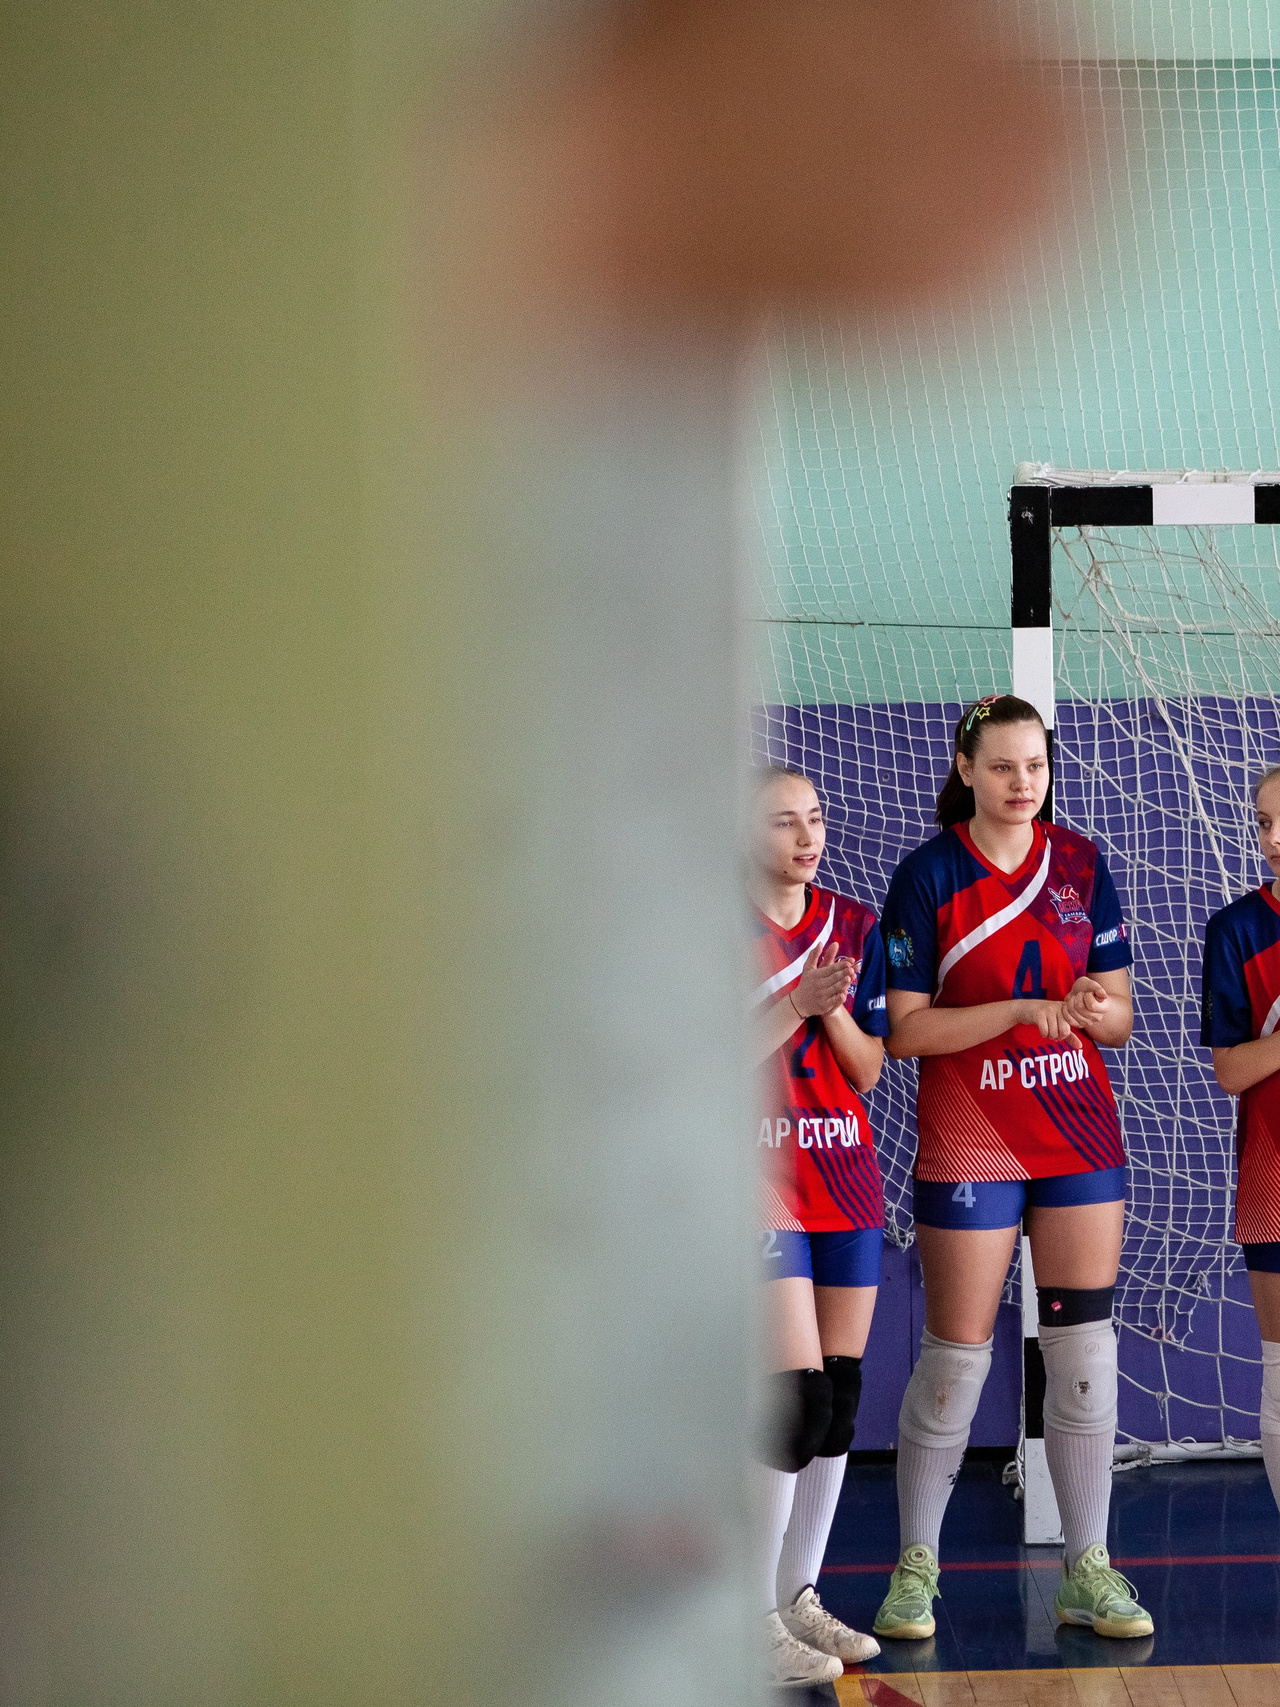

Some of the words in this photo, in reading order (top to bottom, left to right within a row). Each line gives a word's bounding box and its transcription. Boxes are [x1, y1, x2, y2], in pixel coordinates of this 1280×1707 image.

[1012, 939, 1048, 1000] 4
[980, 1059, 1014, 1090] АР
[758, 1117, 791, 1148] АР
[951, 1181, 977, 1208] 4
[761, 1228, 783, 1260] 2
